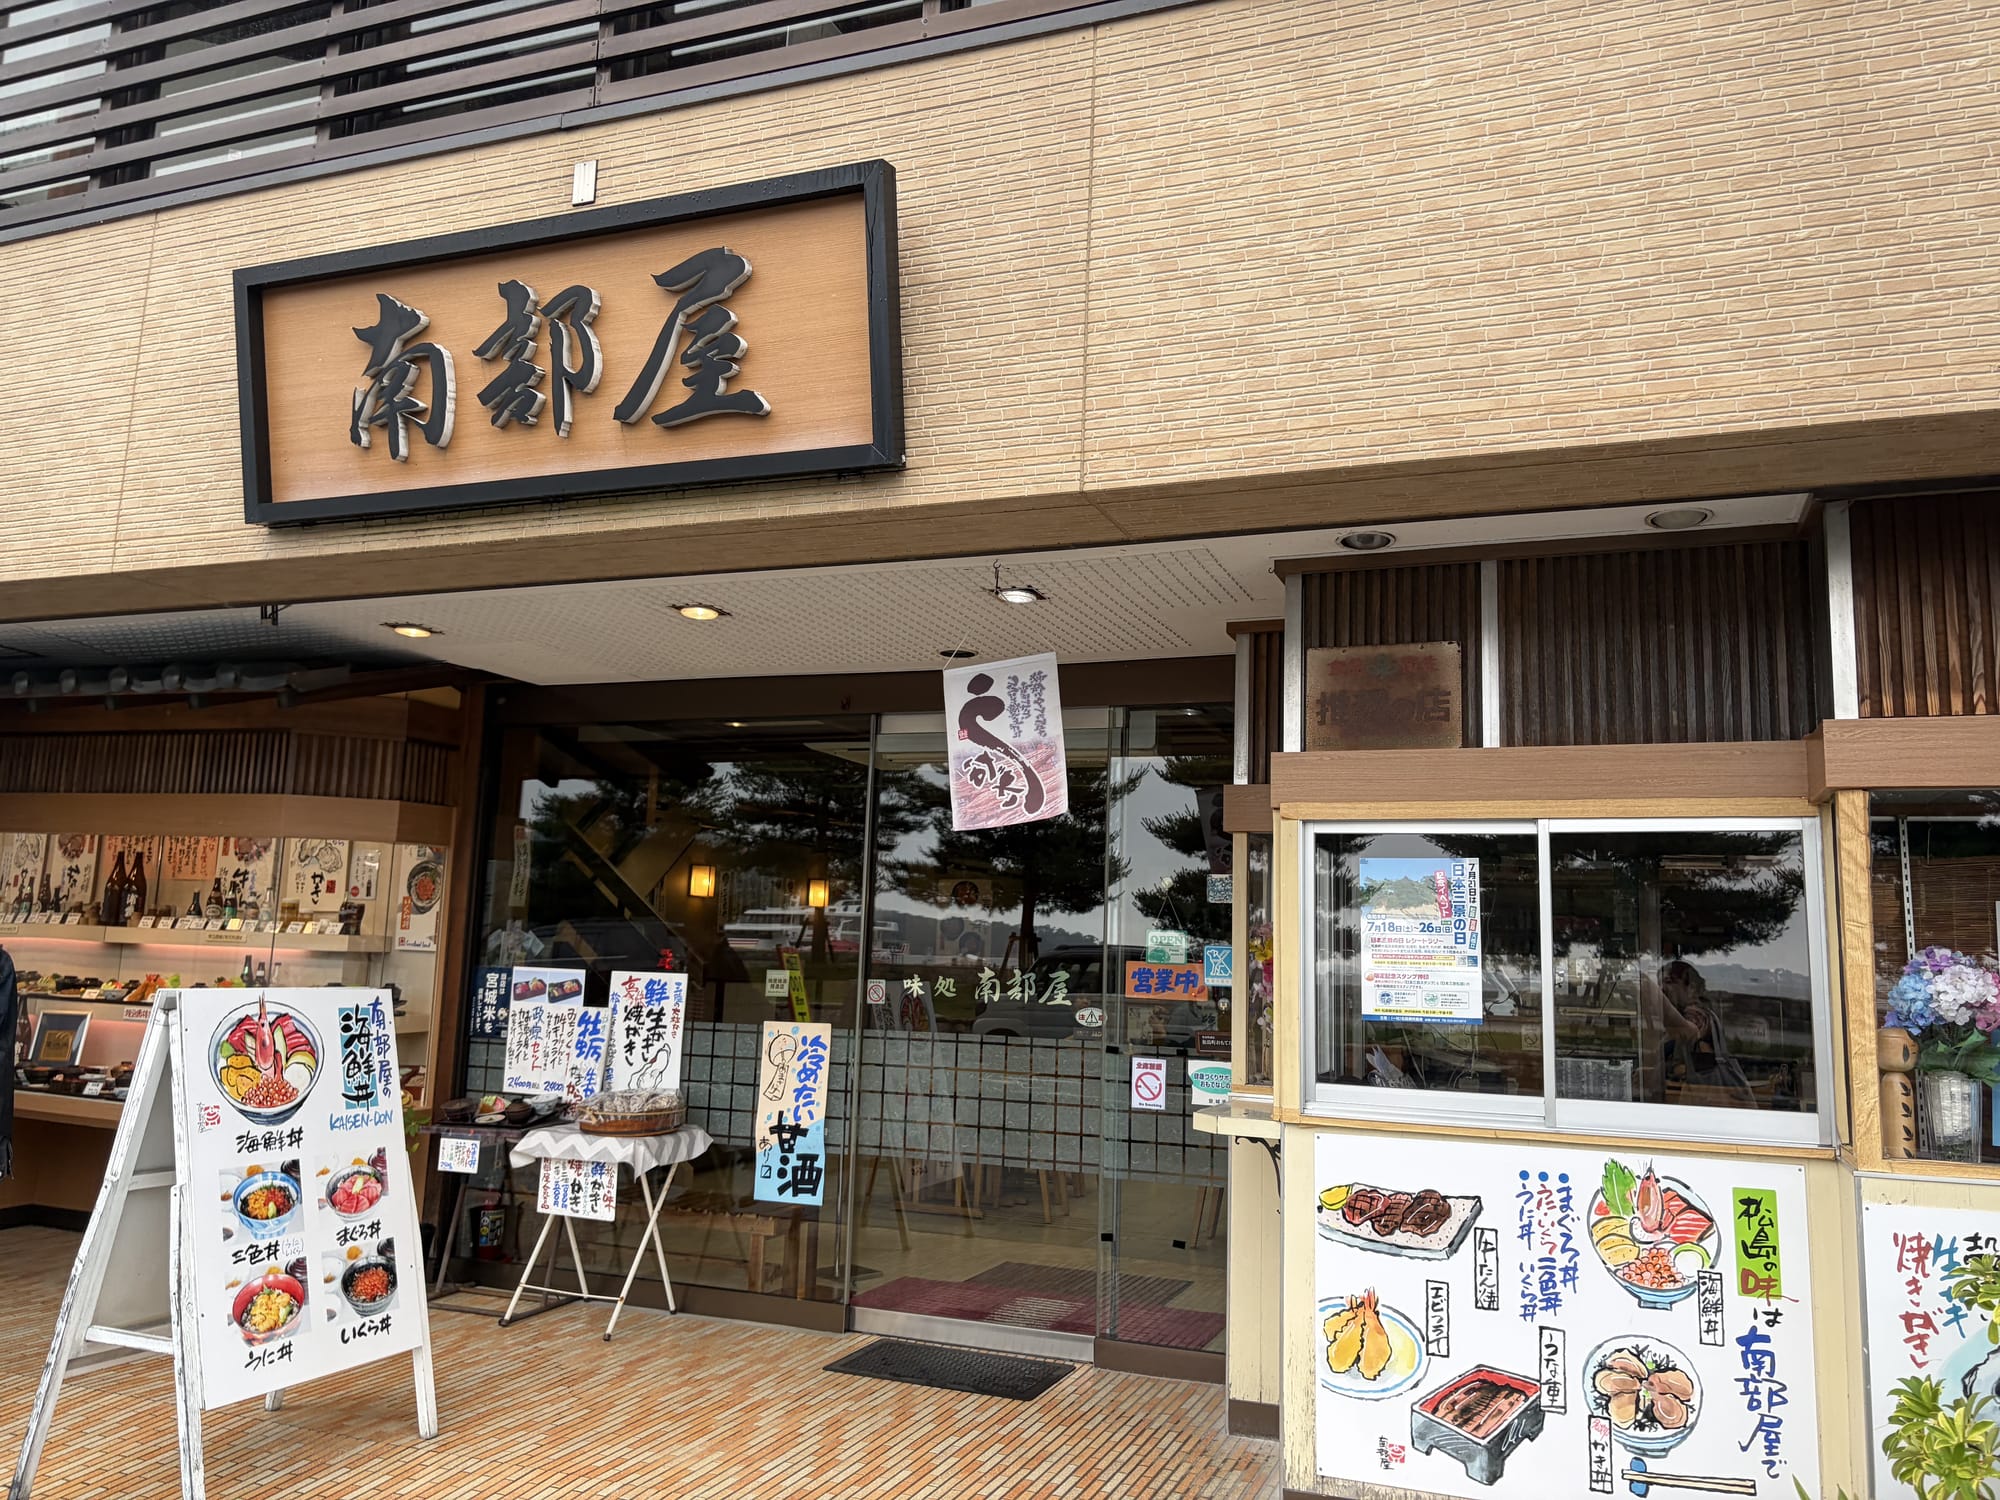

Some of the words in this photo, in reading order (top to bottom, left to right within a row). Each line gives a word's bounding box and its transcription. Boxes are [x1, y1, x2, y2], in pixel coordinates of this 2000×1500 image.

[350, 246, 771, 462] 南部屋
[1452, 863, 1467, 945] 日本三景の日
[1468, 863, 1477, 904] 7月21日は
[1150, 935, 1183, 945] OPEN
[483, 973, 499, 1033] 宮城米を
[903, 974, 957, 998] 味処
[974, 966, 1072, 1006] 南部屋
[340, 1003, 376, 1112] 海鮮丼
[368, 995, 393, 1098] 南部屋の
[530, 1006, 545, 1072] 政宗セット
[550, 1014, 561, 1070] カキフライ
[793, 1034, 828, 1122] 冷めたい
[236, 1125, 304, 1154] 海鮮丼
[329, 1110, 393, 1131] KAISEN-DON
[769, 1110, 823, 1197] 甘酒
[336, 1218, 381, 1246] まぐろ丼
[1515, 1183, 1535, 1251] うに丼
[1557, 1185, 1581, 1294] まぐろ丼
[1478, 1230, 1498, 1309] 牛たん焼
[1519, 1262, 1538, 1323] いくら丼
[1893, 1232, 1943, 1369] 焼きがき
[340, 1313, 392, 1345] いくら丼
[1429, 1287, 1447, 1355] エビフライ
[1699, 1273, 1723, 1337] 海鮮丼
[244, 1341, 293, 1371] うに丼
[1543, 1332, 1561, 1410] うな重
